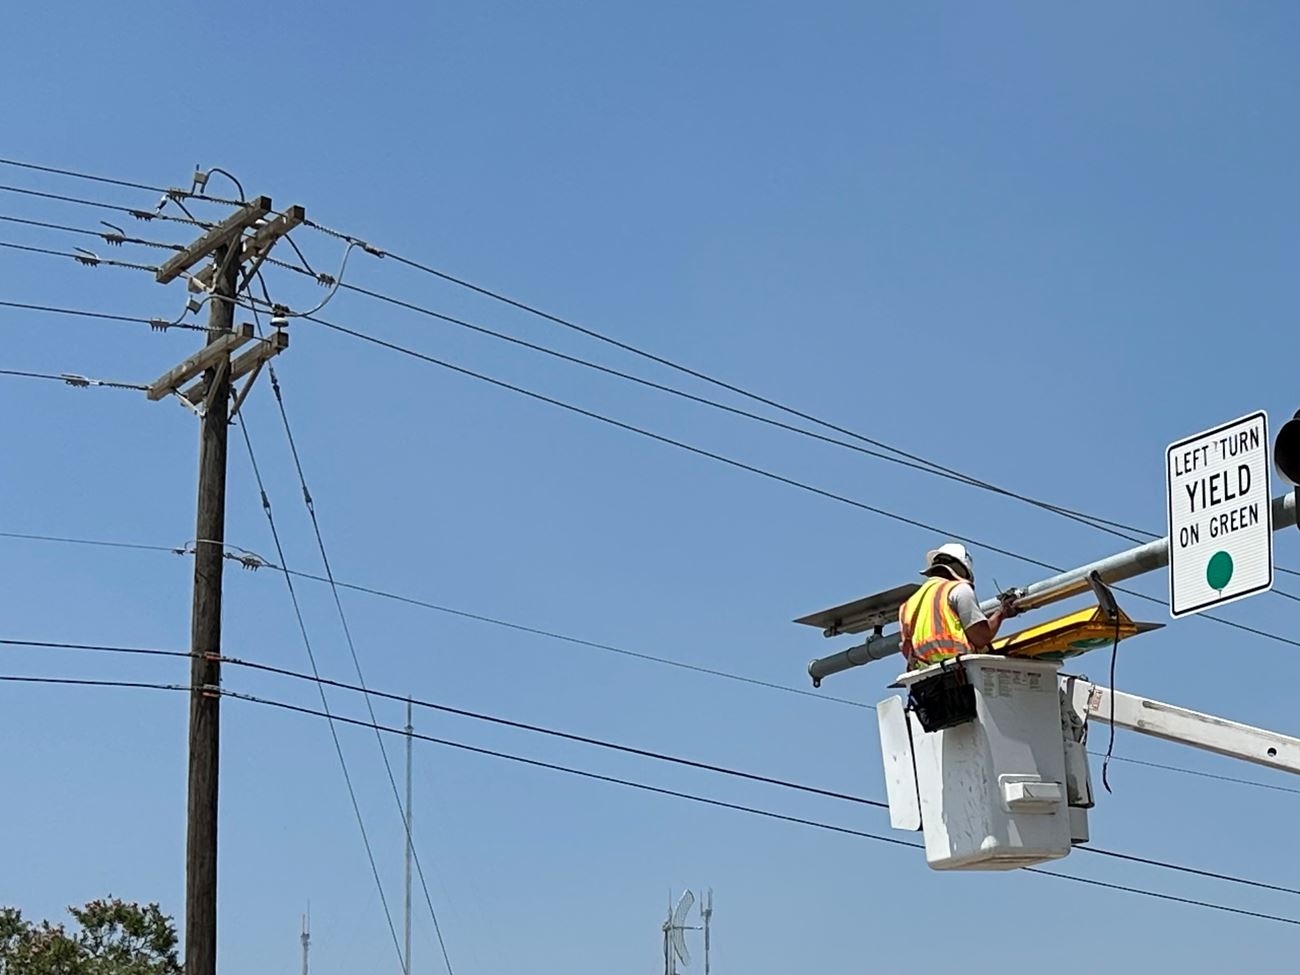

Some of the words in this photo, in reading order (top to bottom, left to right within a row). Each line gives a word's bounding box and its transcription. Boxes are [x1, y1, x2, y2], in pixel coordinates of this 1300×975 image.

[1175, 445, 1210, 477] LEFT
[1219, 426, 1260, 460] TURN
[1185, 464, 1251, 513] YIELD
[1179, 523, 1199, 548] ON
[1209, 503, 1259, 538] GREEN
